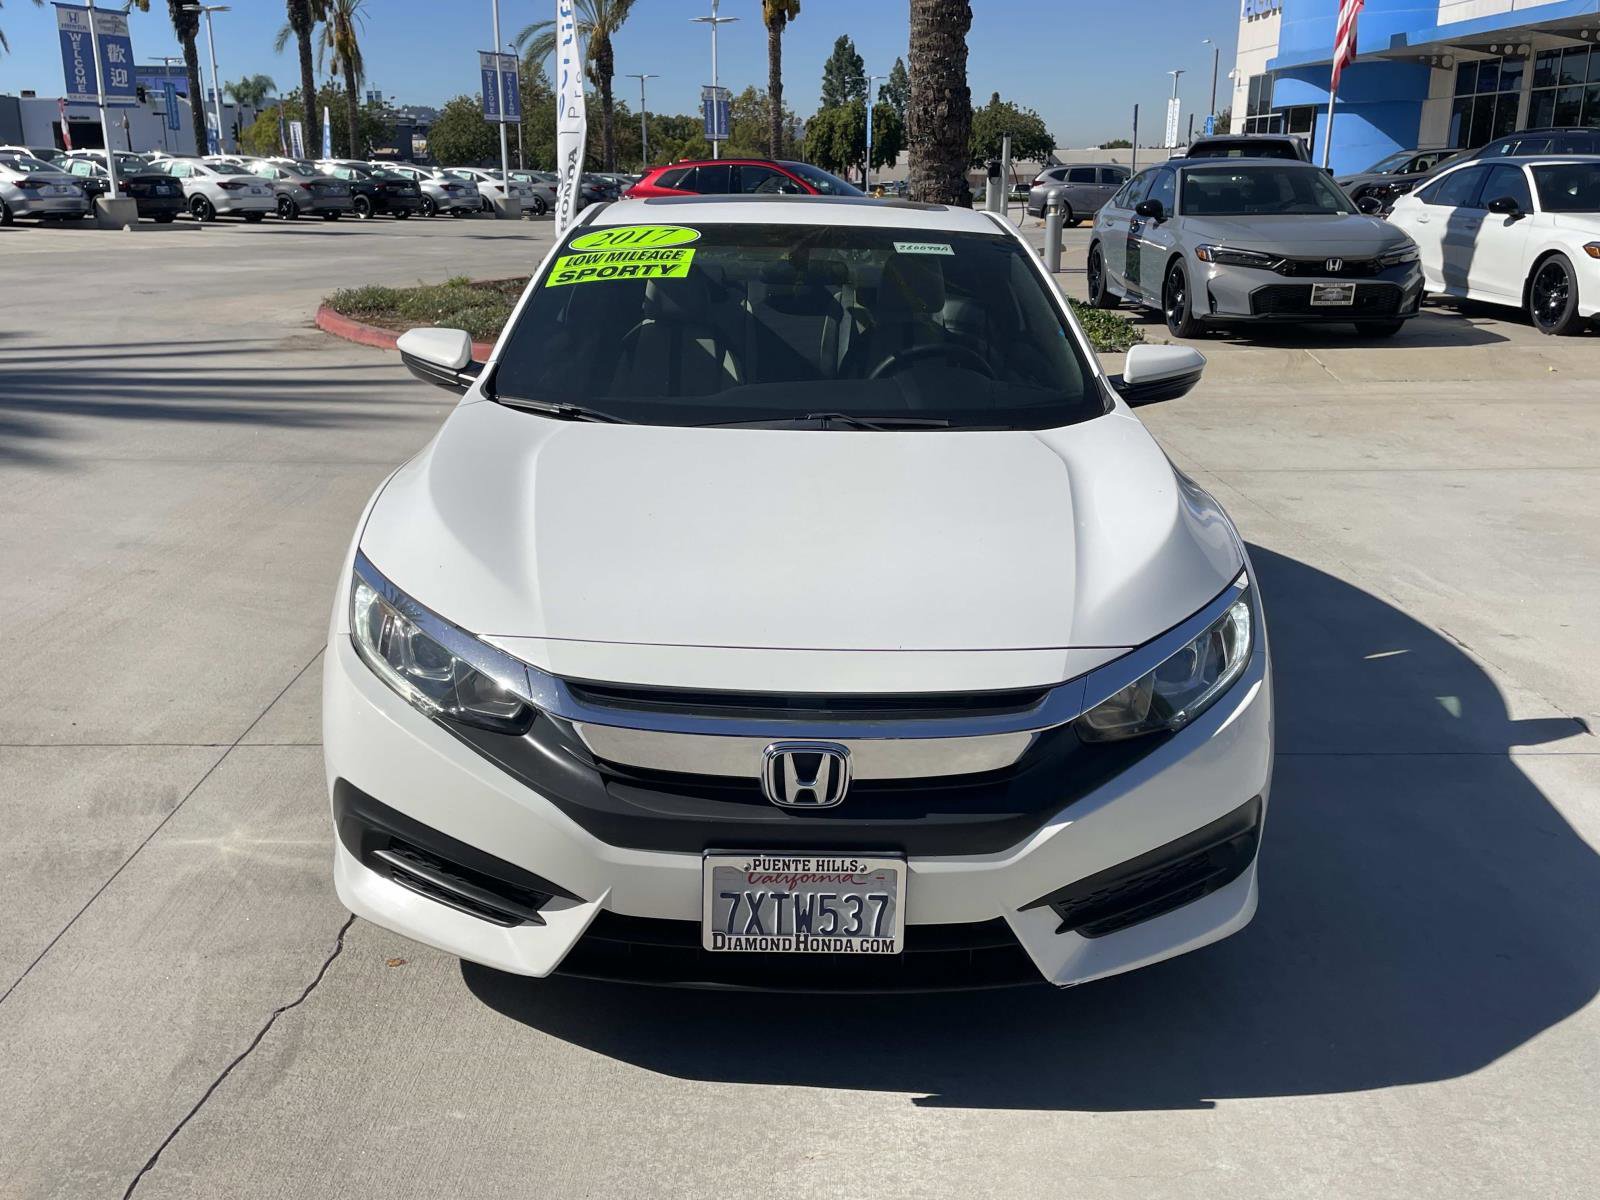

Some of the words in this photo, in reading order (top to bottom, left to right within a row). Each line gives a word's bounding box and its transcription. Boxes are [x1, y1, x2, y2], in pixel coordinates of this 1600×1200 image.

[67, 32, 87, 93] WELCOME
[106, 43, 128, 87] 歡迎
[487, 71, 496, 114] WELCOME
[560, 146, 578, 232] HONDA
[587, 229, 680, 248] 2017
[555, 264, 679, 283] SPORTY
[564, 253, 604, 268] LOW
[604, 249, 686, 263] MILEAGE
[747, 872, 867, 891] California
[752, 859, 811, 872] PUENTE
[815, 859, 858, 873] HILLS
[719, 892, 889, 937] 7XTW537
